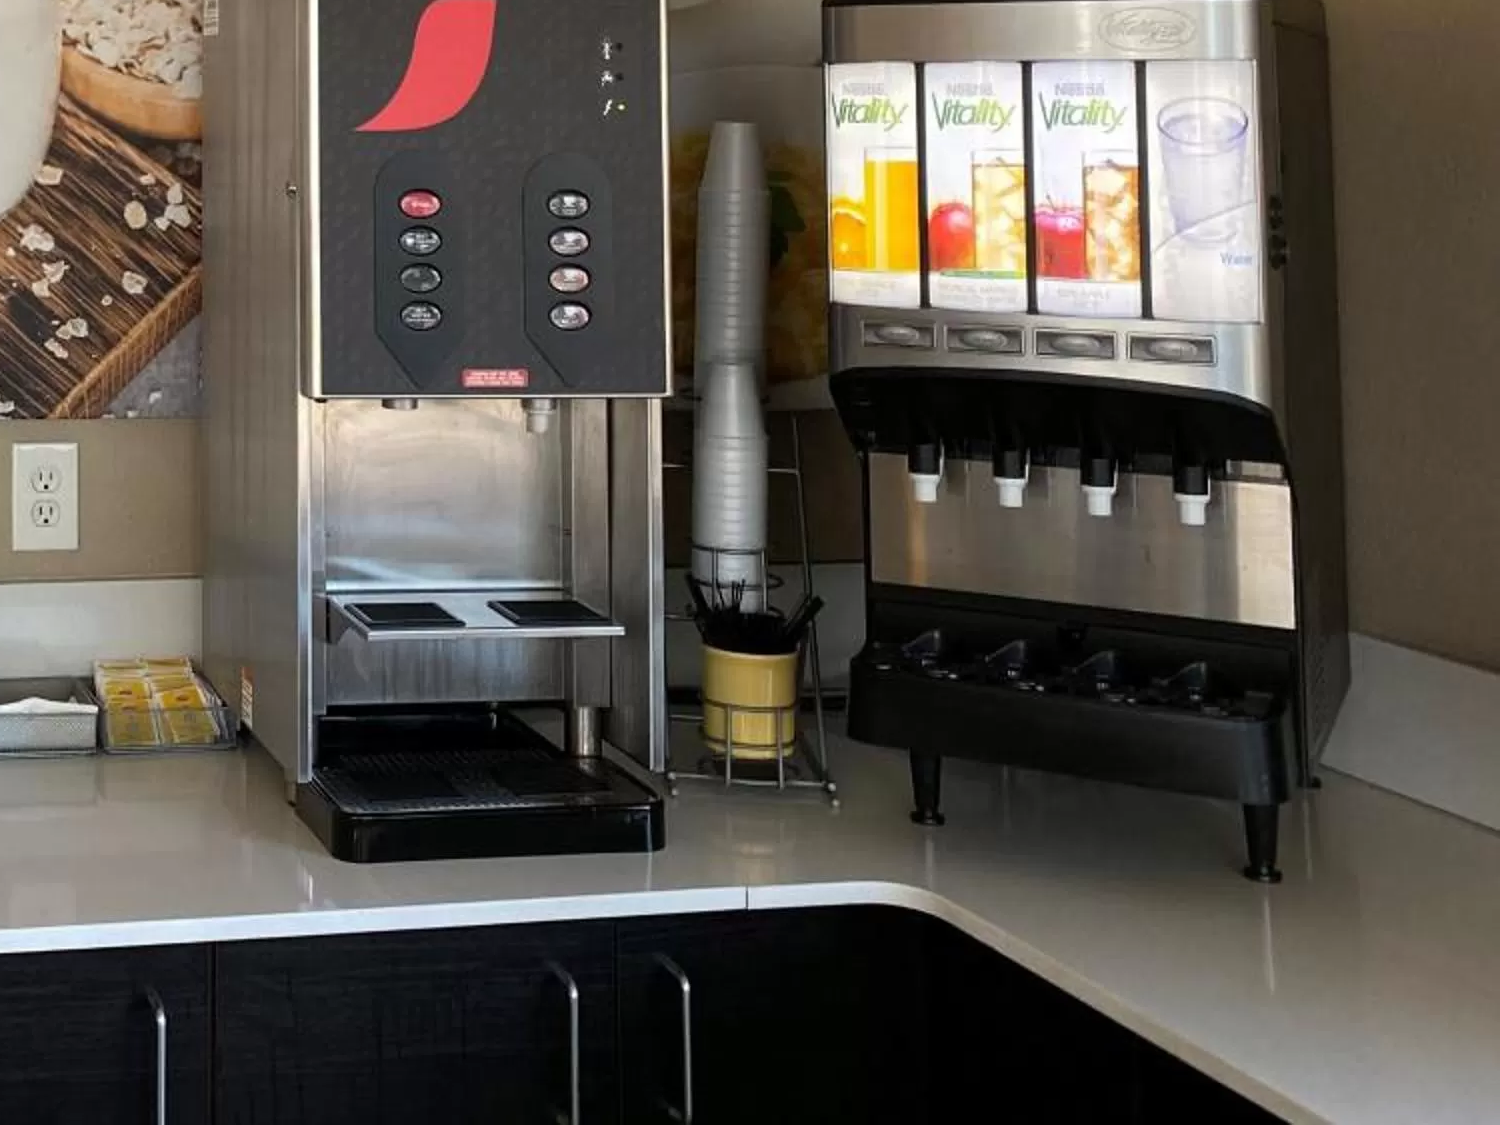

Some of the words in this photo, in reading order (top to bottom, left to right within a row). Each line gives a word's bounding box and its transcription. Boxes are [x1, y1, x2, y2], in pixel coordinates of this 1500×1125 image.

[831, 91, 909, 131] Vitality
[931, 91, 1016, 133] Vitality
[1038, 91, 1128, 134] Vitality
